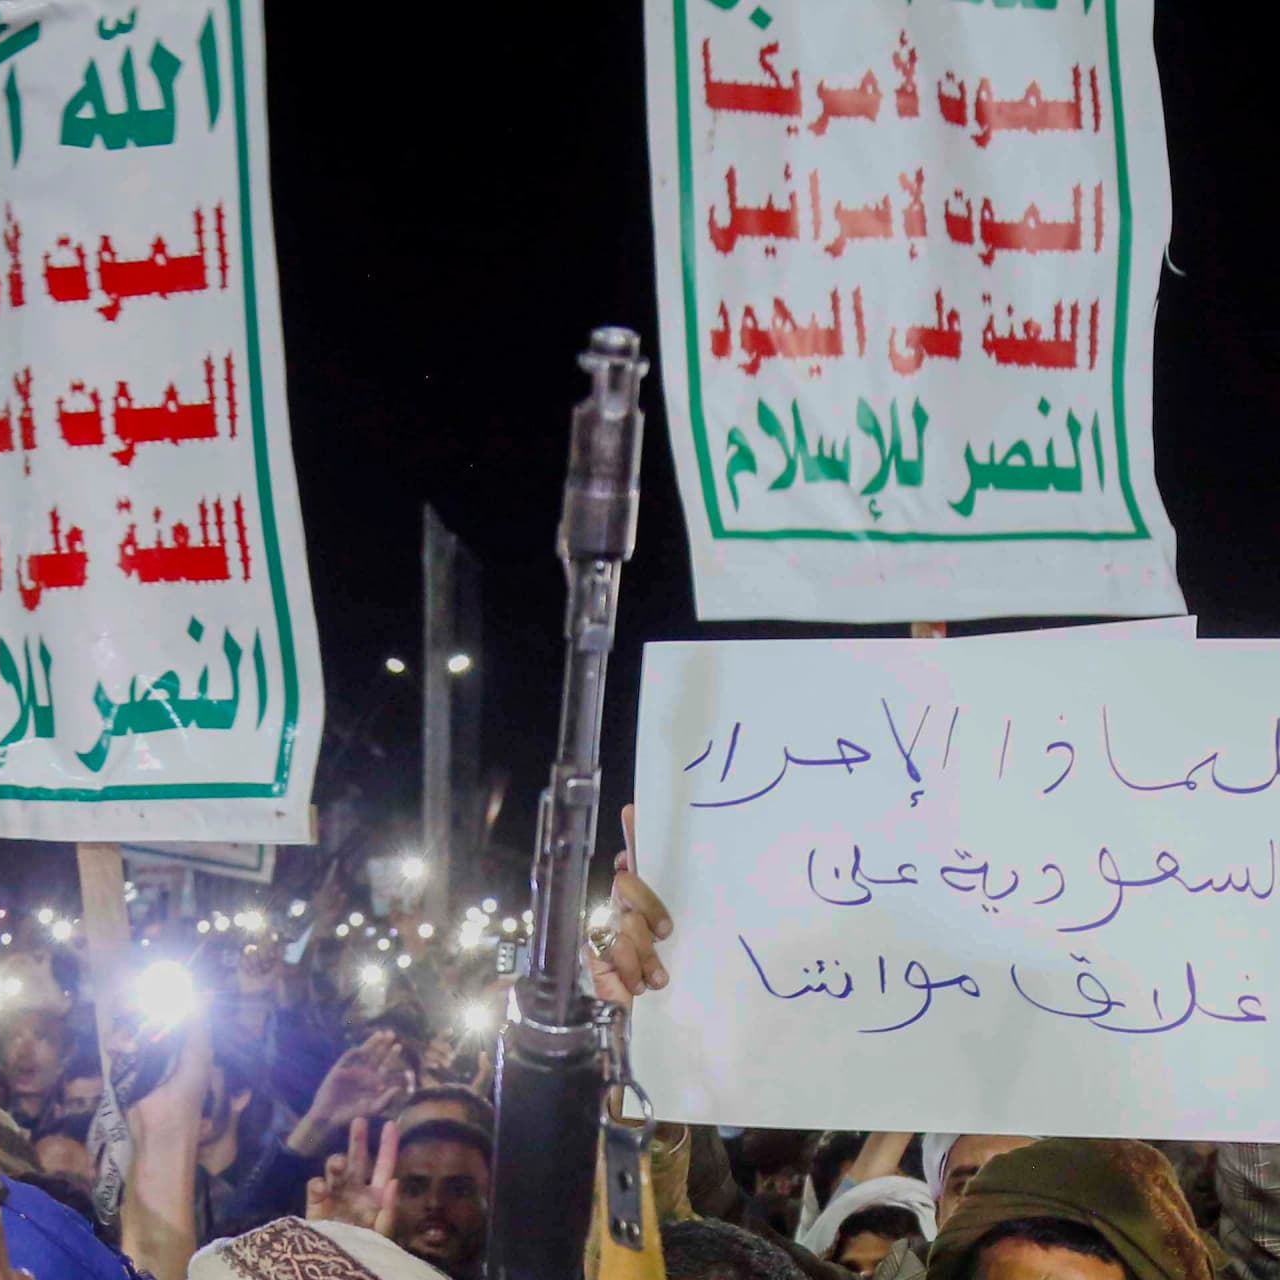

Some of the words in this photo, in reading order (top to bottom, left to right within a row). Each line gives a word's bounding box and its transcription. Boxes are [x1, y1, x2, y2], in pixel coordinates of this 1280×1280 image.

[702, 30, 920, 136] لأمريكا
[936, 64, 1102, 148] الموت
[708, 164, 928, 260] لإسرائيل
[943, 181, 1104, 267] الموت
[42, 200, 230, 323] الموت
[710, 285, 867, 377] اليهود
[888, 288, 963, 376] على
[981, 292, 1099, 371] اللعنة
[55, 352, 239, 468] الموت
[725, 396, 930, 520] للإسلام
[948, 396, 1106, 518] النصر
[17, 506, 90, 613] على
[116, 494, 252, 585] اللعنة
[75, 615, 269, 773] النصر
[806, 843, 919, 906] على
